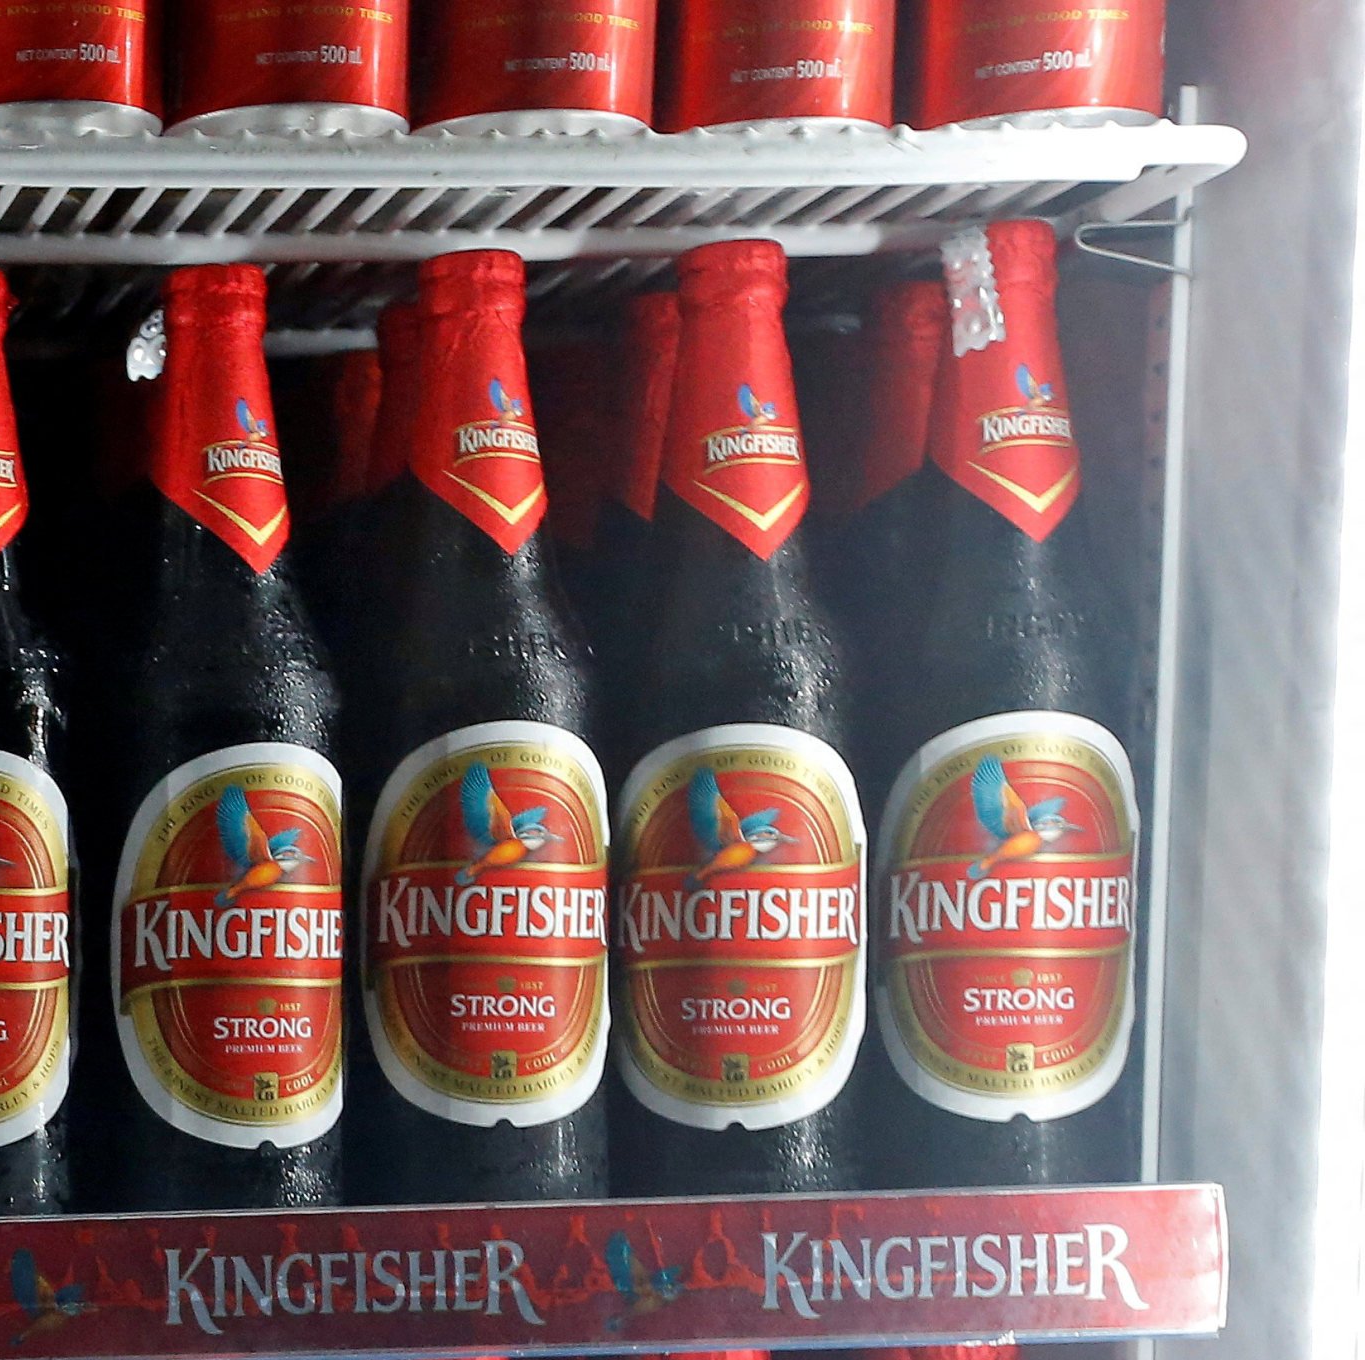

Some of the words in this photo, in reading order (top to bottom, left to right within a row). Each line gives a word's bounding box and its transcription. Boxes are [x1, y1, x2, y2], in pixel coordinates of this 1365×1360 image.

[80, 43, 106, 62] 500
[320, 45, 347, 64] 500
[569, 52, 596, 71] 500
[1042, 49, 1073, 71] 500
[797, 59, 824, 79] 500
[707, 433, 800, 462] KINGFISHER
[379, 876, 607, 947] KINGFISHER
[618, 885, 857, 953] KINGFISHER
[890, 871, 1131, 943] KINGFISHER
[449, 993, 556, 1017] STRONG
[681, 996, 791, 1020] STRONG
[963, 987, 1075, 1013] STRONG
[213, 1016, 313, 1040] STRONG
[461, 1022, 515, 1033] PREMIUM
[517, 1022, 546, 1033] BEER
[225, 1043, 275, 1054] PREMIUM
[278, 1043, 303, 1053] BEER
[762, 1223, 1150, 1320] KINGFISHER
[165, 1239, 545, 1336] KINGFISHER
